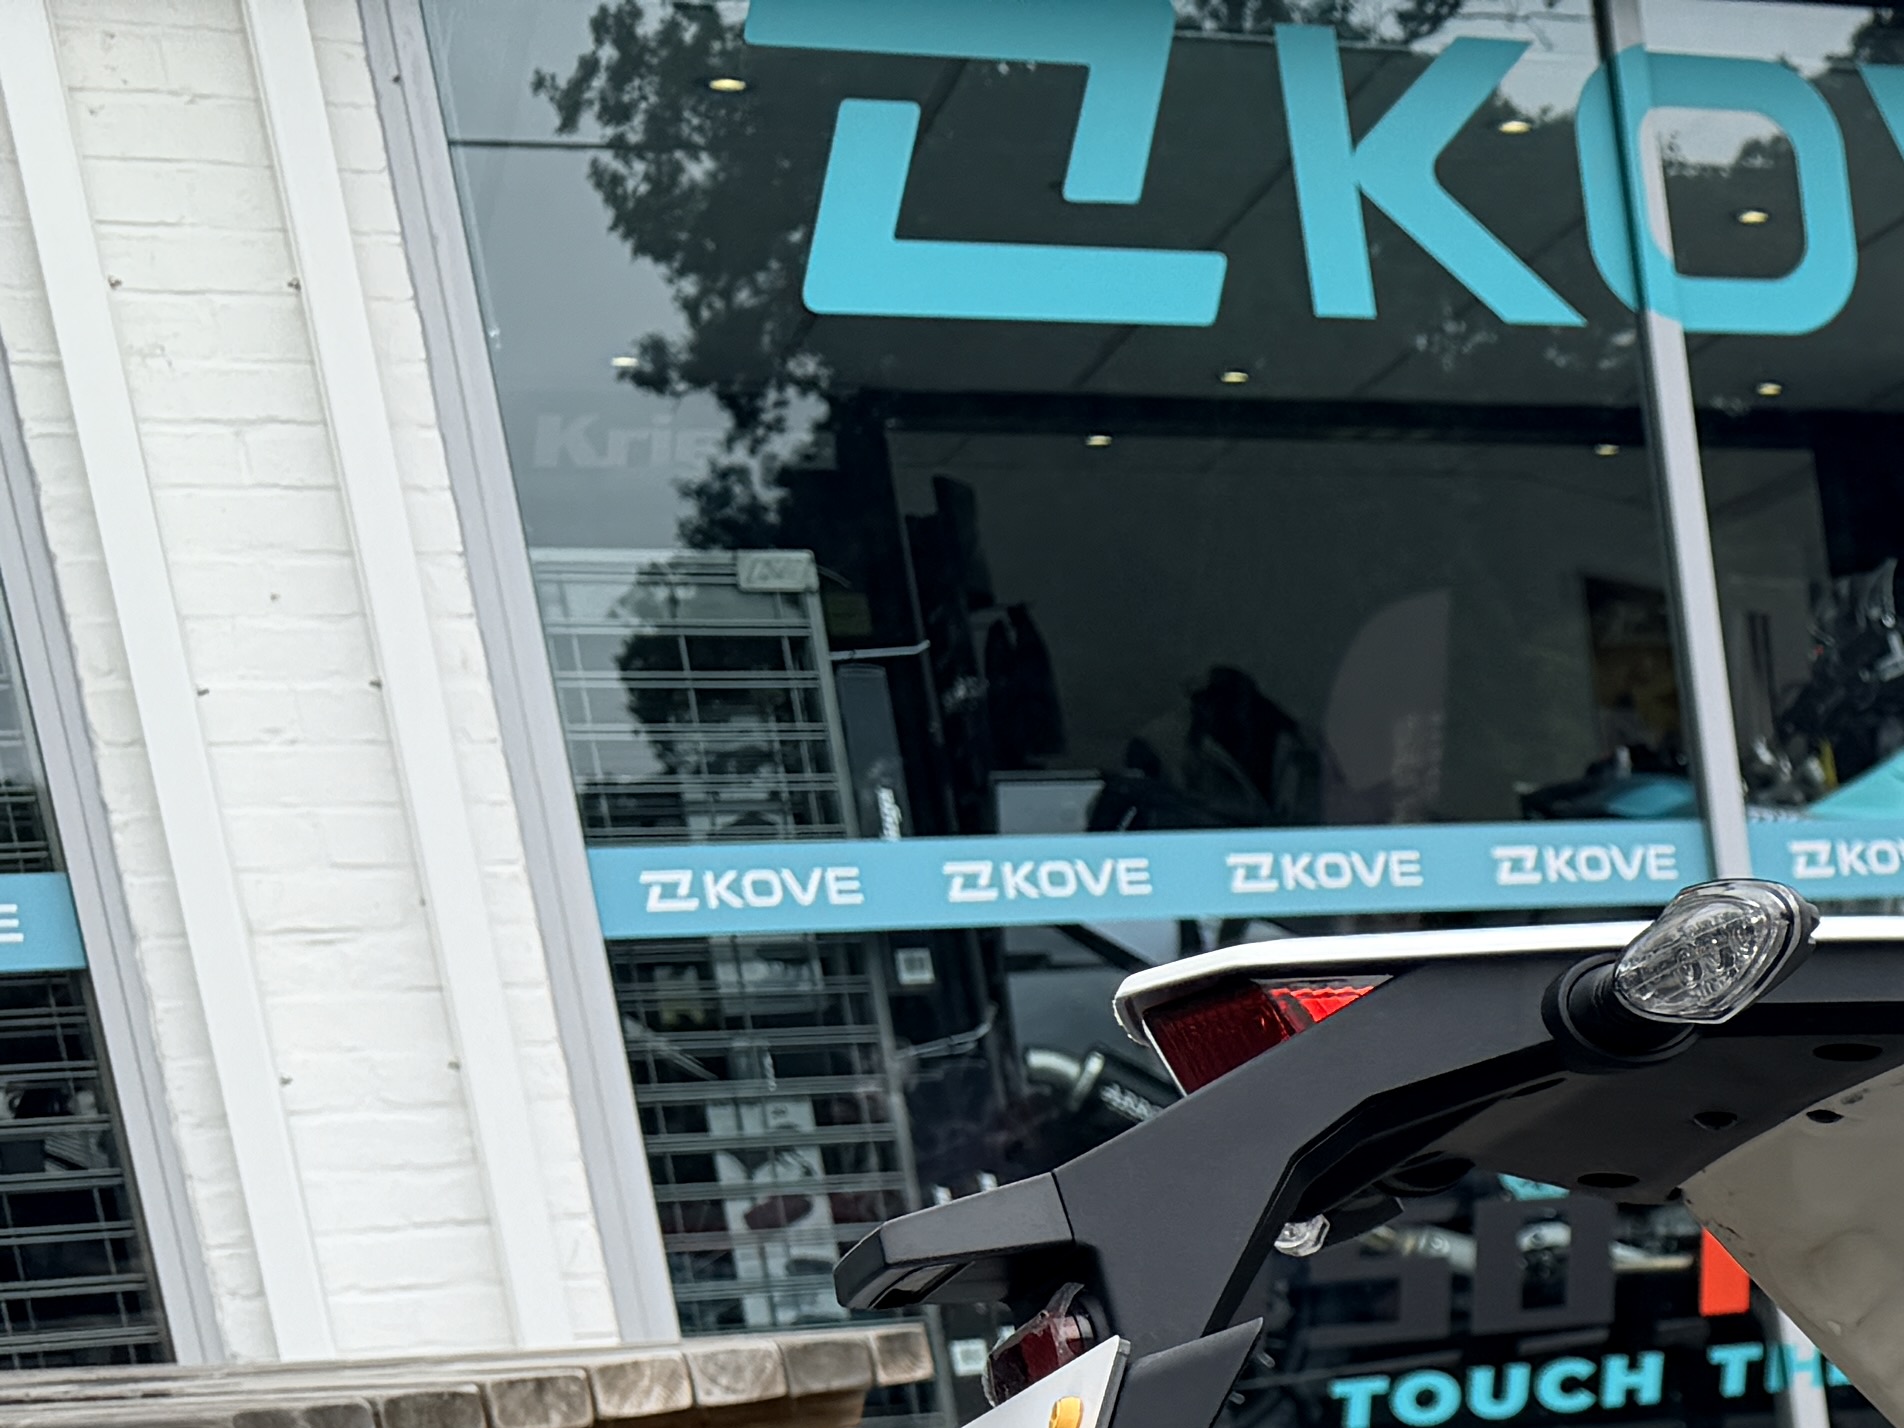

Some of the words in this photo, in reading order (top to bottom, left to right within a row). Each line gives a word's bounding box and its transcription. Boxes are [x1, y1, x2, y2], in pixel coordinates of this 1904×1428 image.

[1000, 856, 1153, 900] KOVE
[1277, 847, 1423, 891] KOVE
[1541, 843, 1680, 884] KOVE
[702, 866, 865, 909] KOVE
